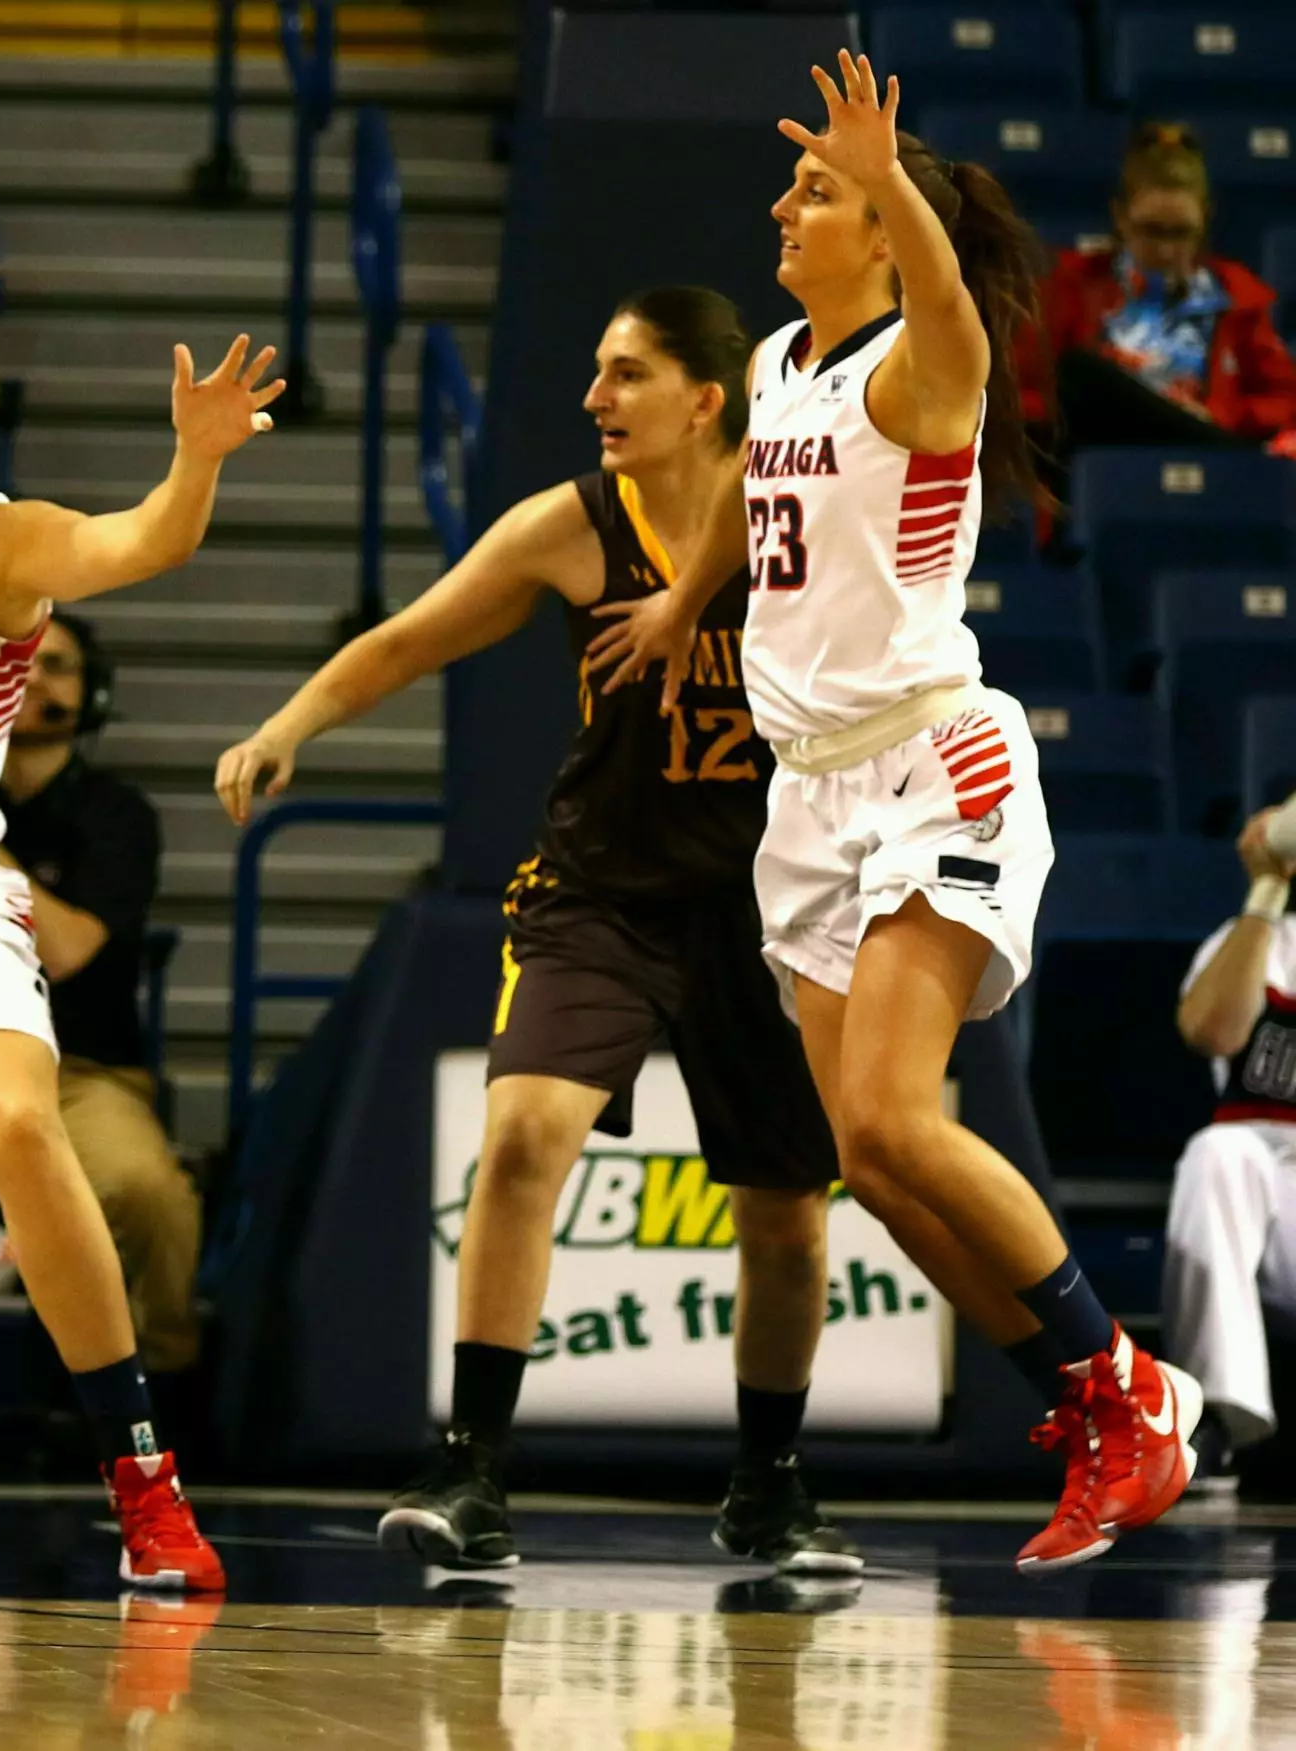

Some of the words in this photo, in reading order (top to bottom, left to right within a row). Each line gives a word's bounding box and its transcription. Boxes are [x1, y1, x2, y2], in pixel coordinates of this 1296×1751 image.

[745, 435, 839, 479] NZAGA
[748, 493, 808, 591] 23
[659, 704, 759, 783] 12
[526, 1293, 650, 1363] eat
[676, 1257, 928, 1342] frsh.
